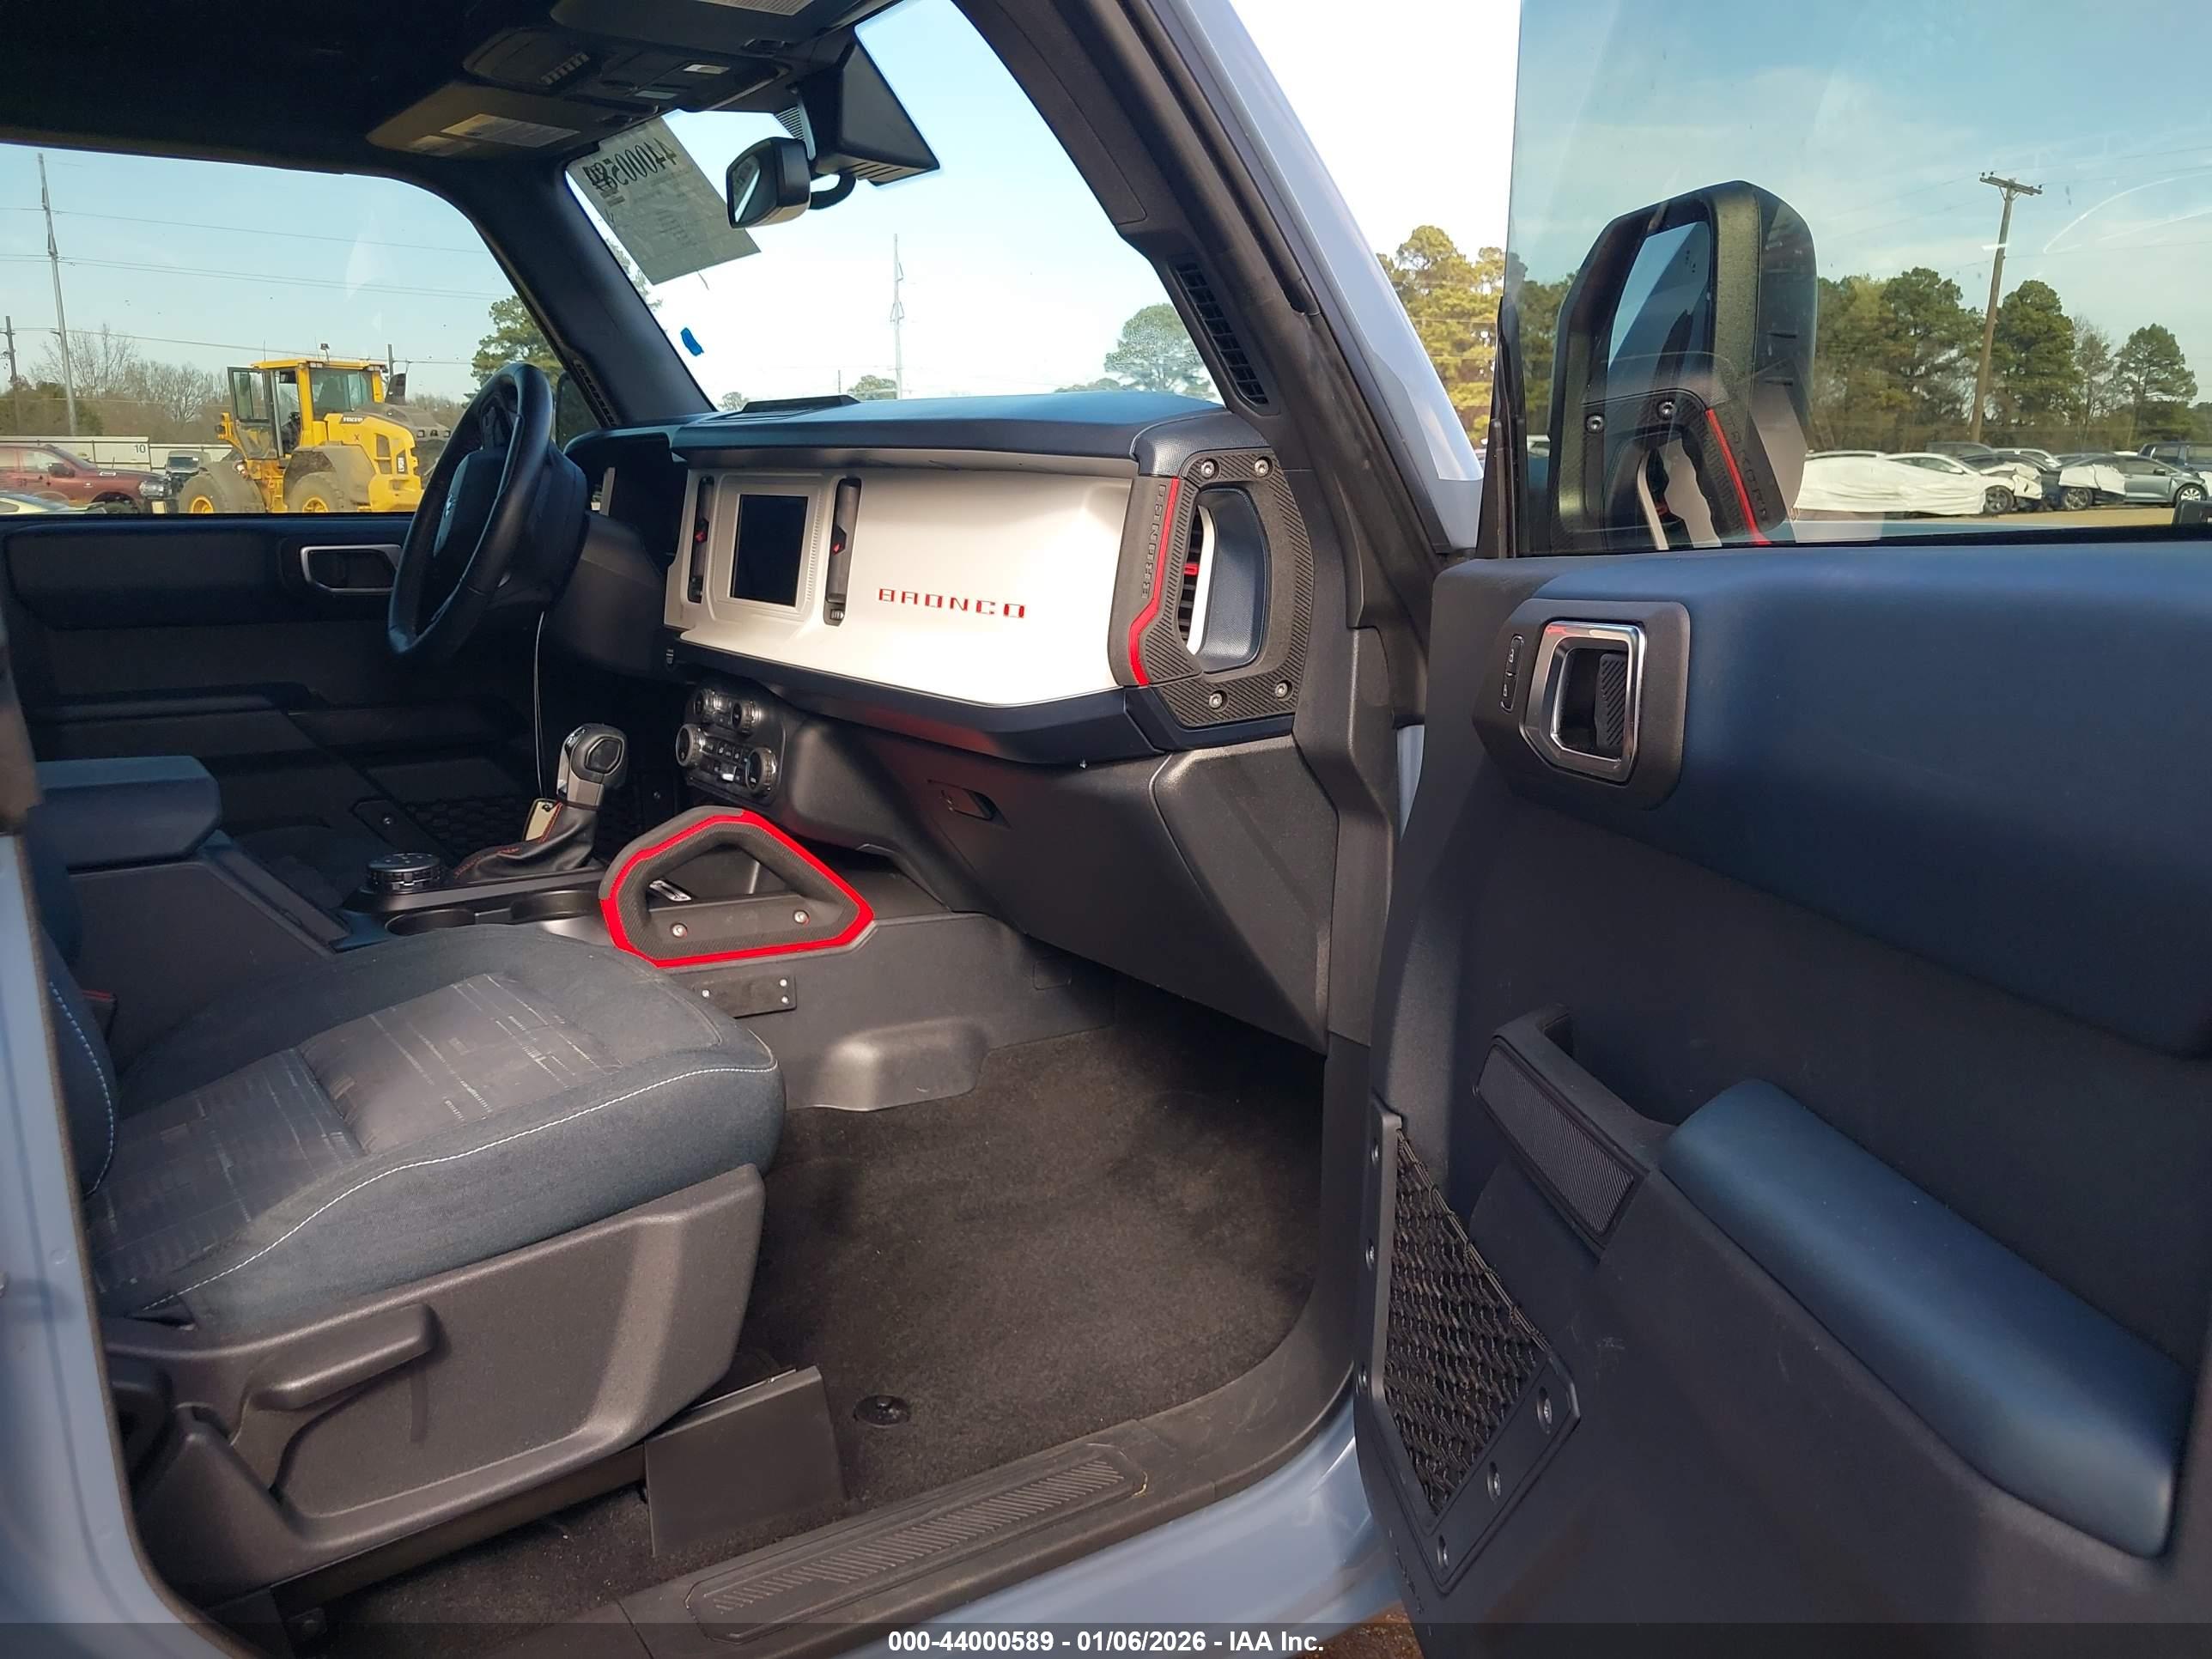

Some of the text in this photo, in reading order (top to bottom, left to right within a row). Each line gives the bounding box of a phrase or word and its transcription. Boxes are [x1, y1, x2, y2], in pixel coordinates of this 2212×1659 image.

[133, 444, 146, 453] 10
[1141, 483, 1167, 599] BRONCO
[878, 588, 1024, 618] BRONCO
